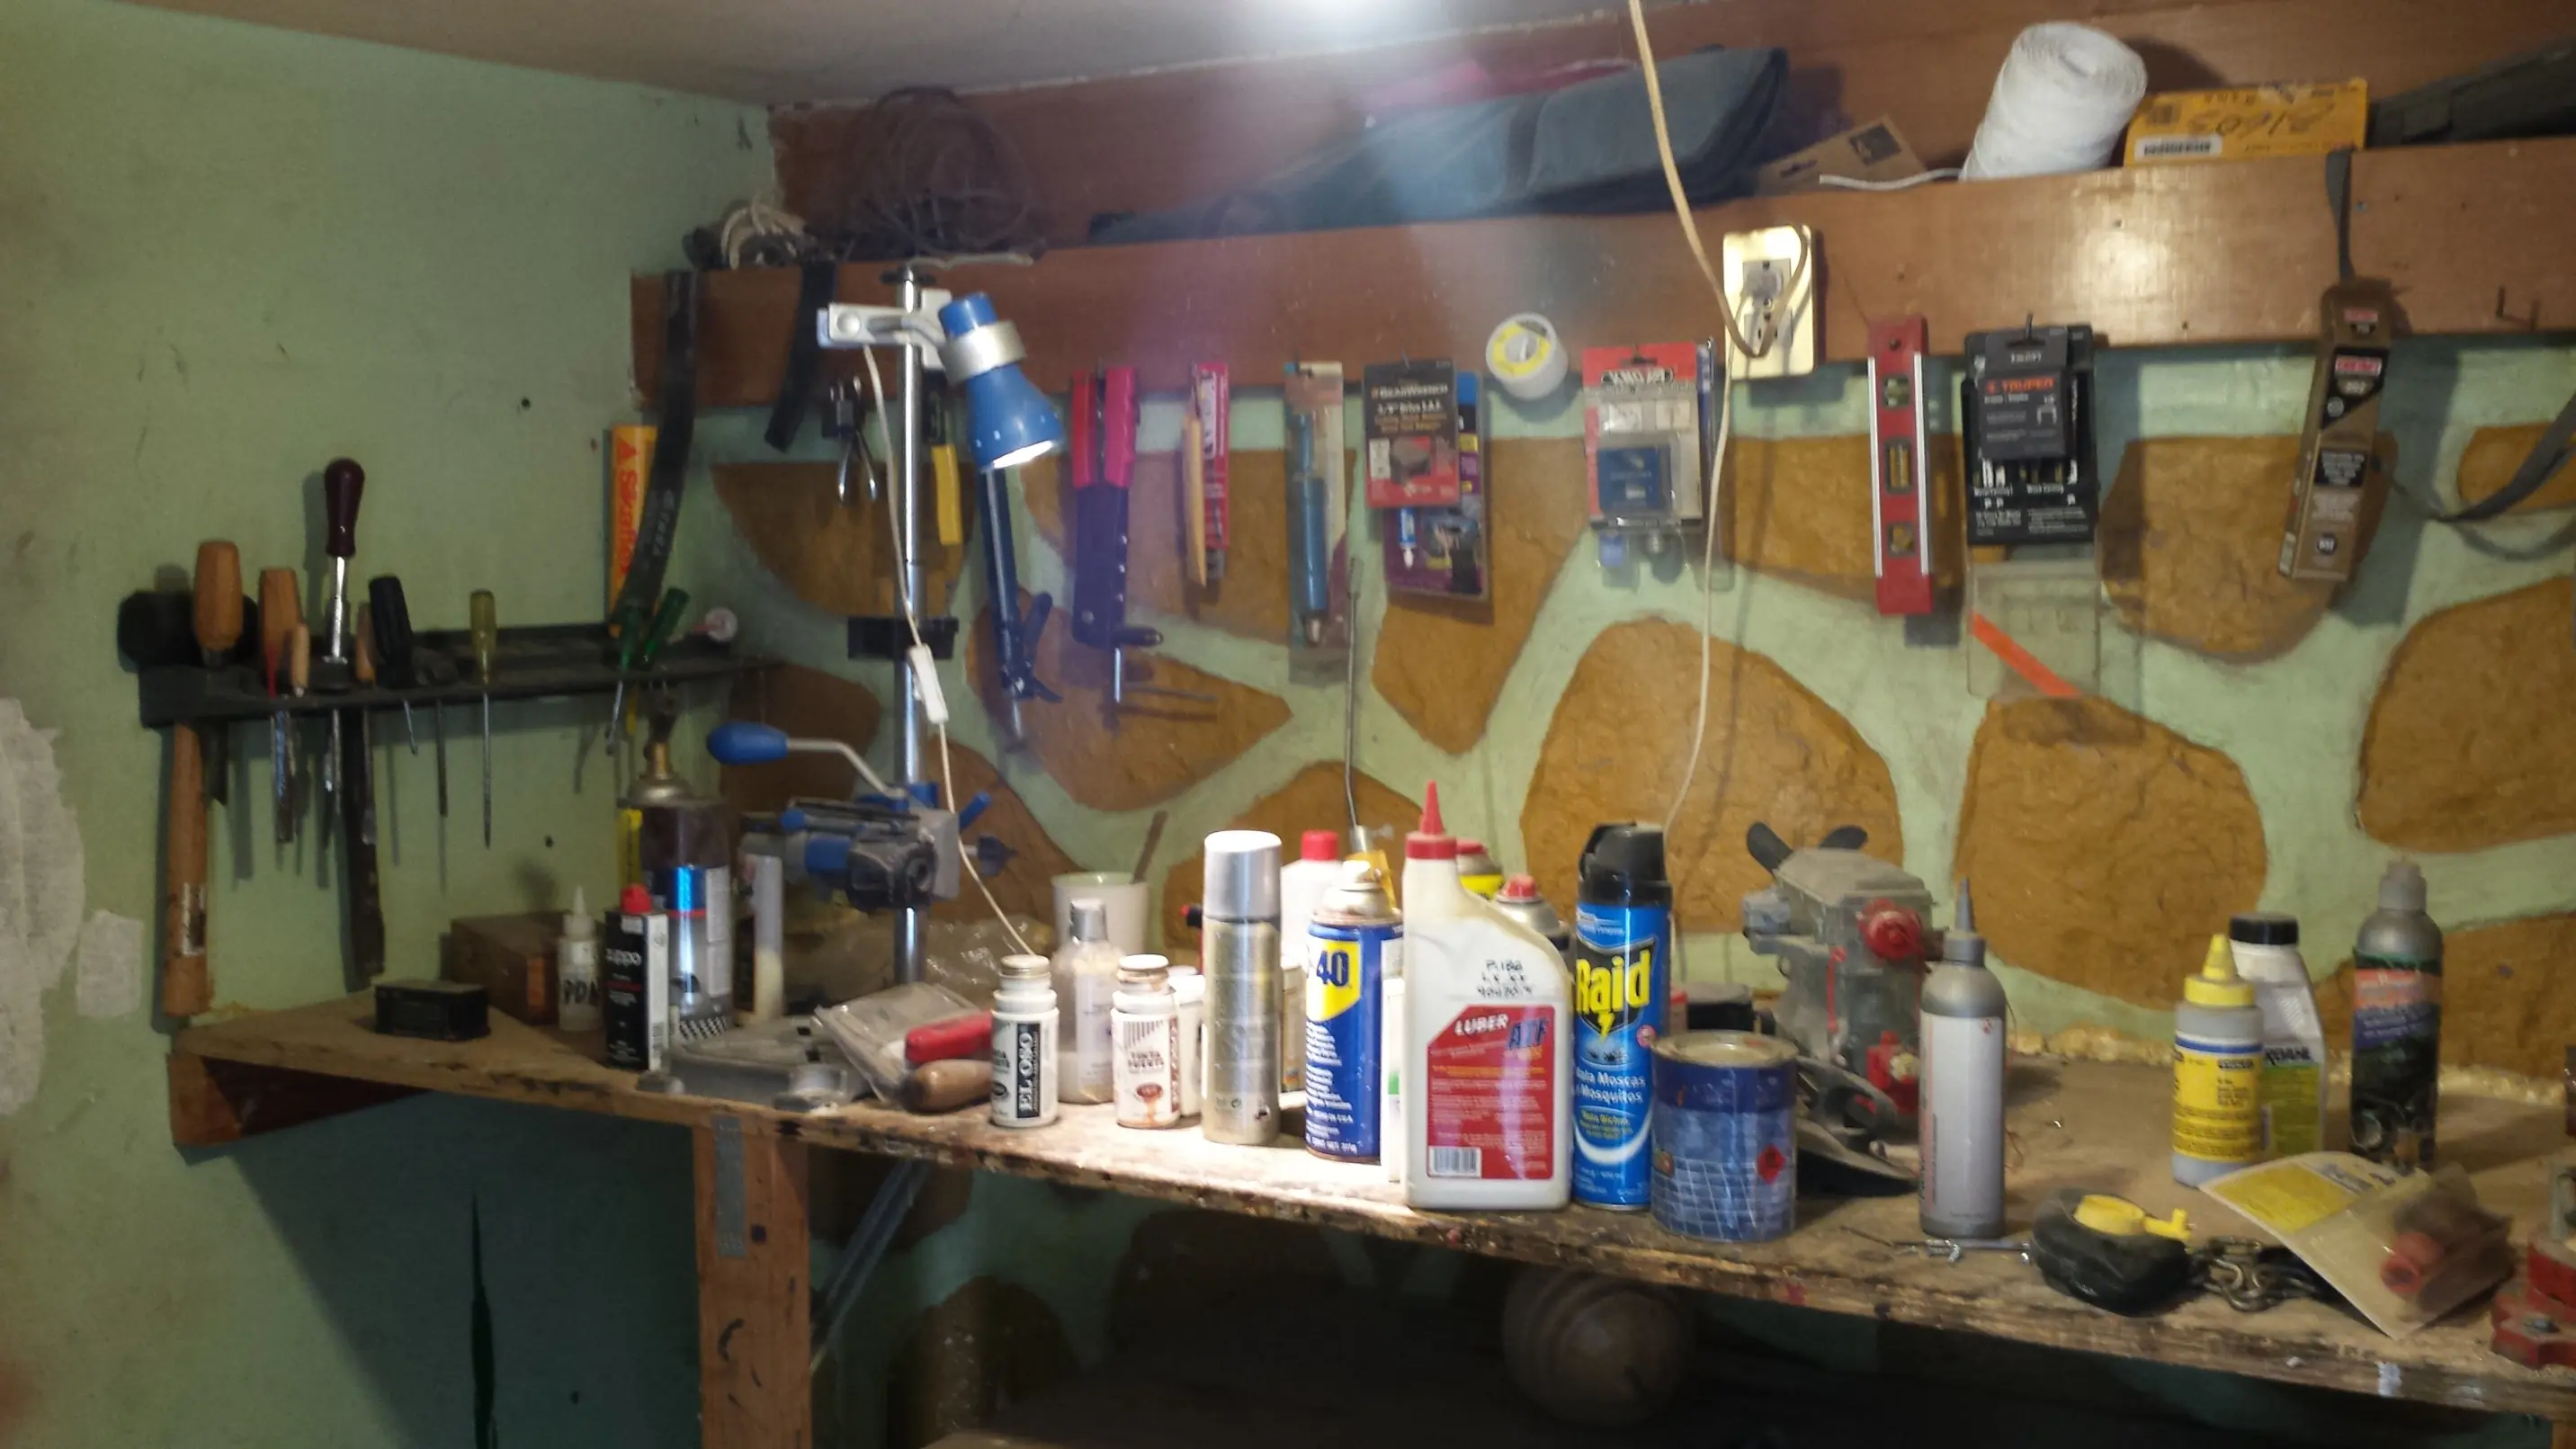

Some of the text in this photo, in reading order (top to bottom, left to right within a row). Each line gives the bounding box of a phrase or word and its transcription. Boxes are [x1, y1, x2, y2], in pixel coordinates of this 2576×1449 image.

[1576, 949, 1651, 1015] Raid
[1453, 1013, 1509, 1036] LUBER
[1018, 1032, 1033, 1112] EL OSO
[1597, 1071, 1646, 1088] Moscas
[1580, 1084, 1644, 1105] Mosquitos
